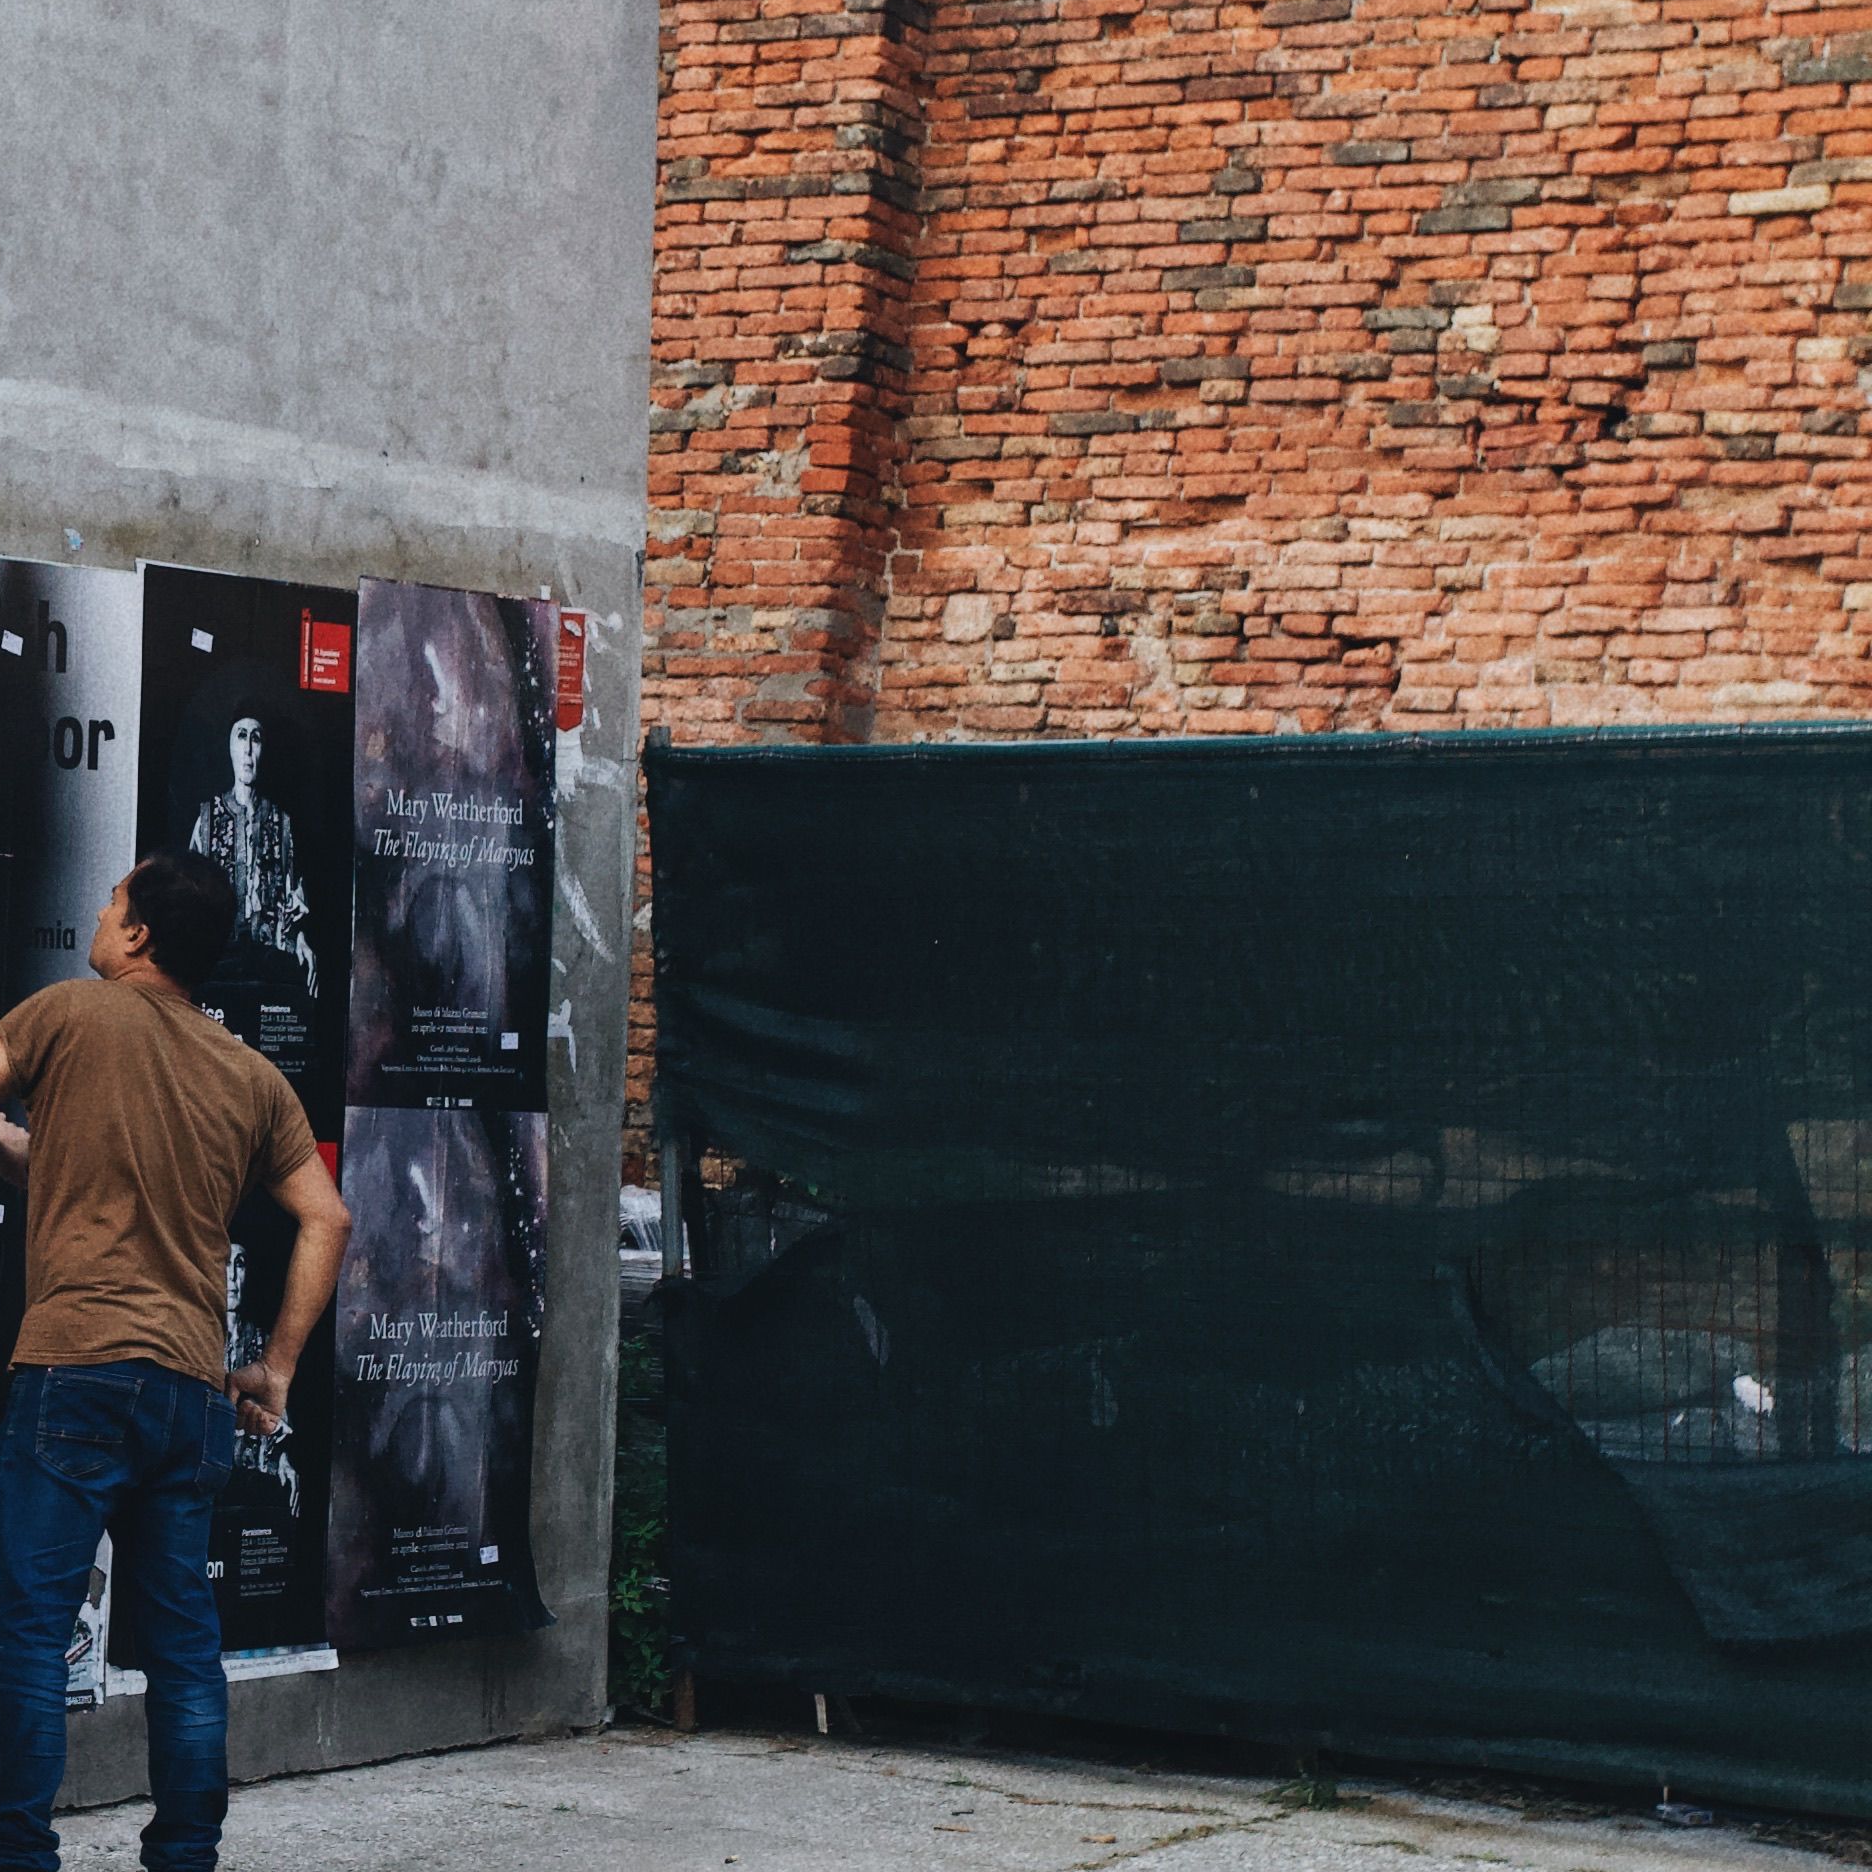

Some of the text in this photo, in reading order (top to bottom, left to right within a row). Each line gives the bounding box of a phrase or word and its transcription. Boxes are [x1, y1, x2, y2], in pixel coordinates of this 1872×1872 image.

[387, 789, 523, 825] Mary Weatherford
[374, 829, 535, 872] The Flaying of Marsyas
[370, 1313, 414, 1346] Mary
[357, 1354, 383, 1381] The
[444, 1352, 462, 1385] of
[461, 1352, 518, 1384] Marsyas
